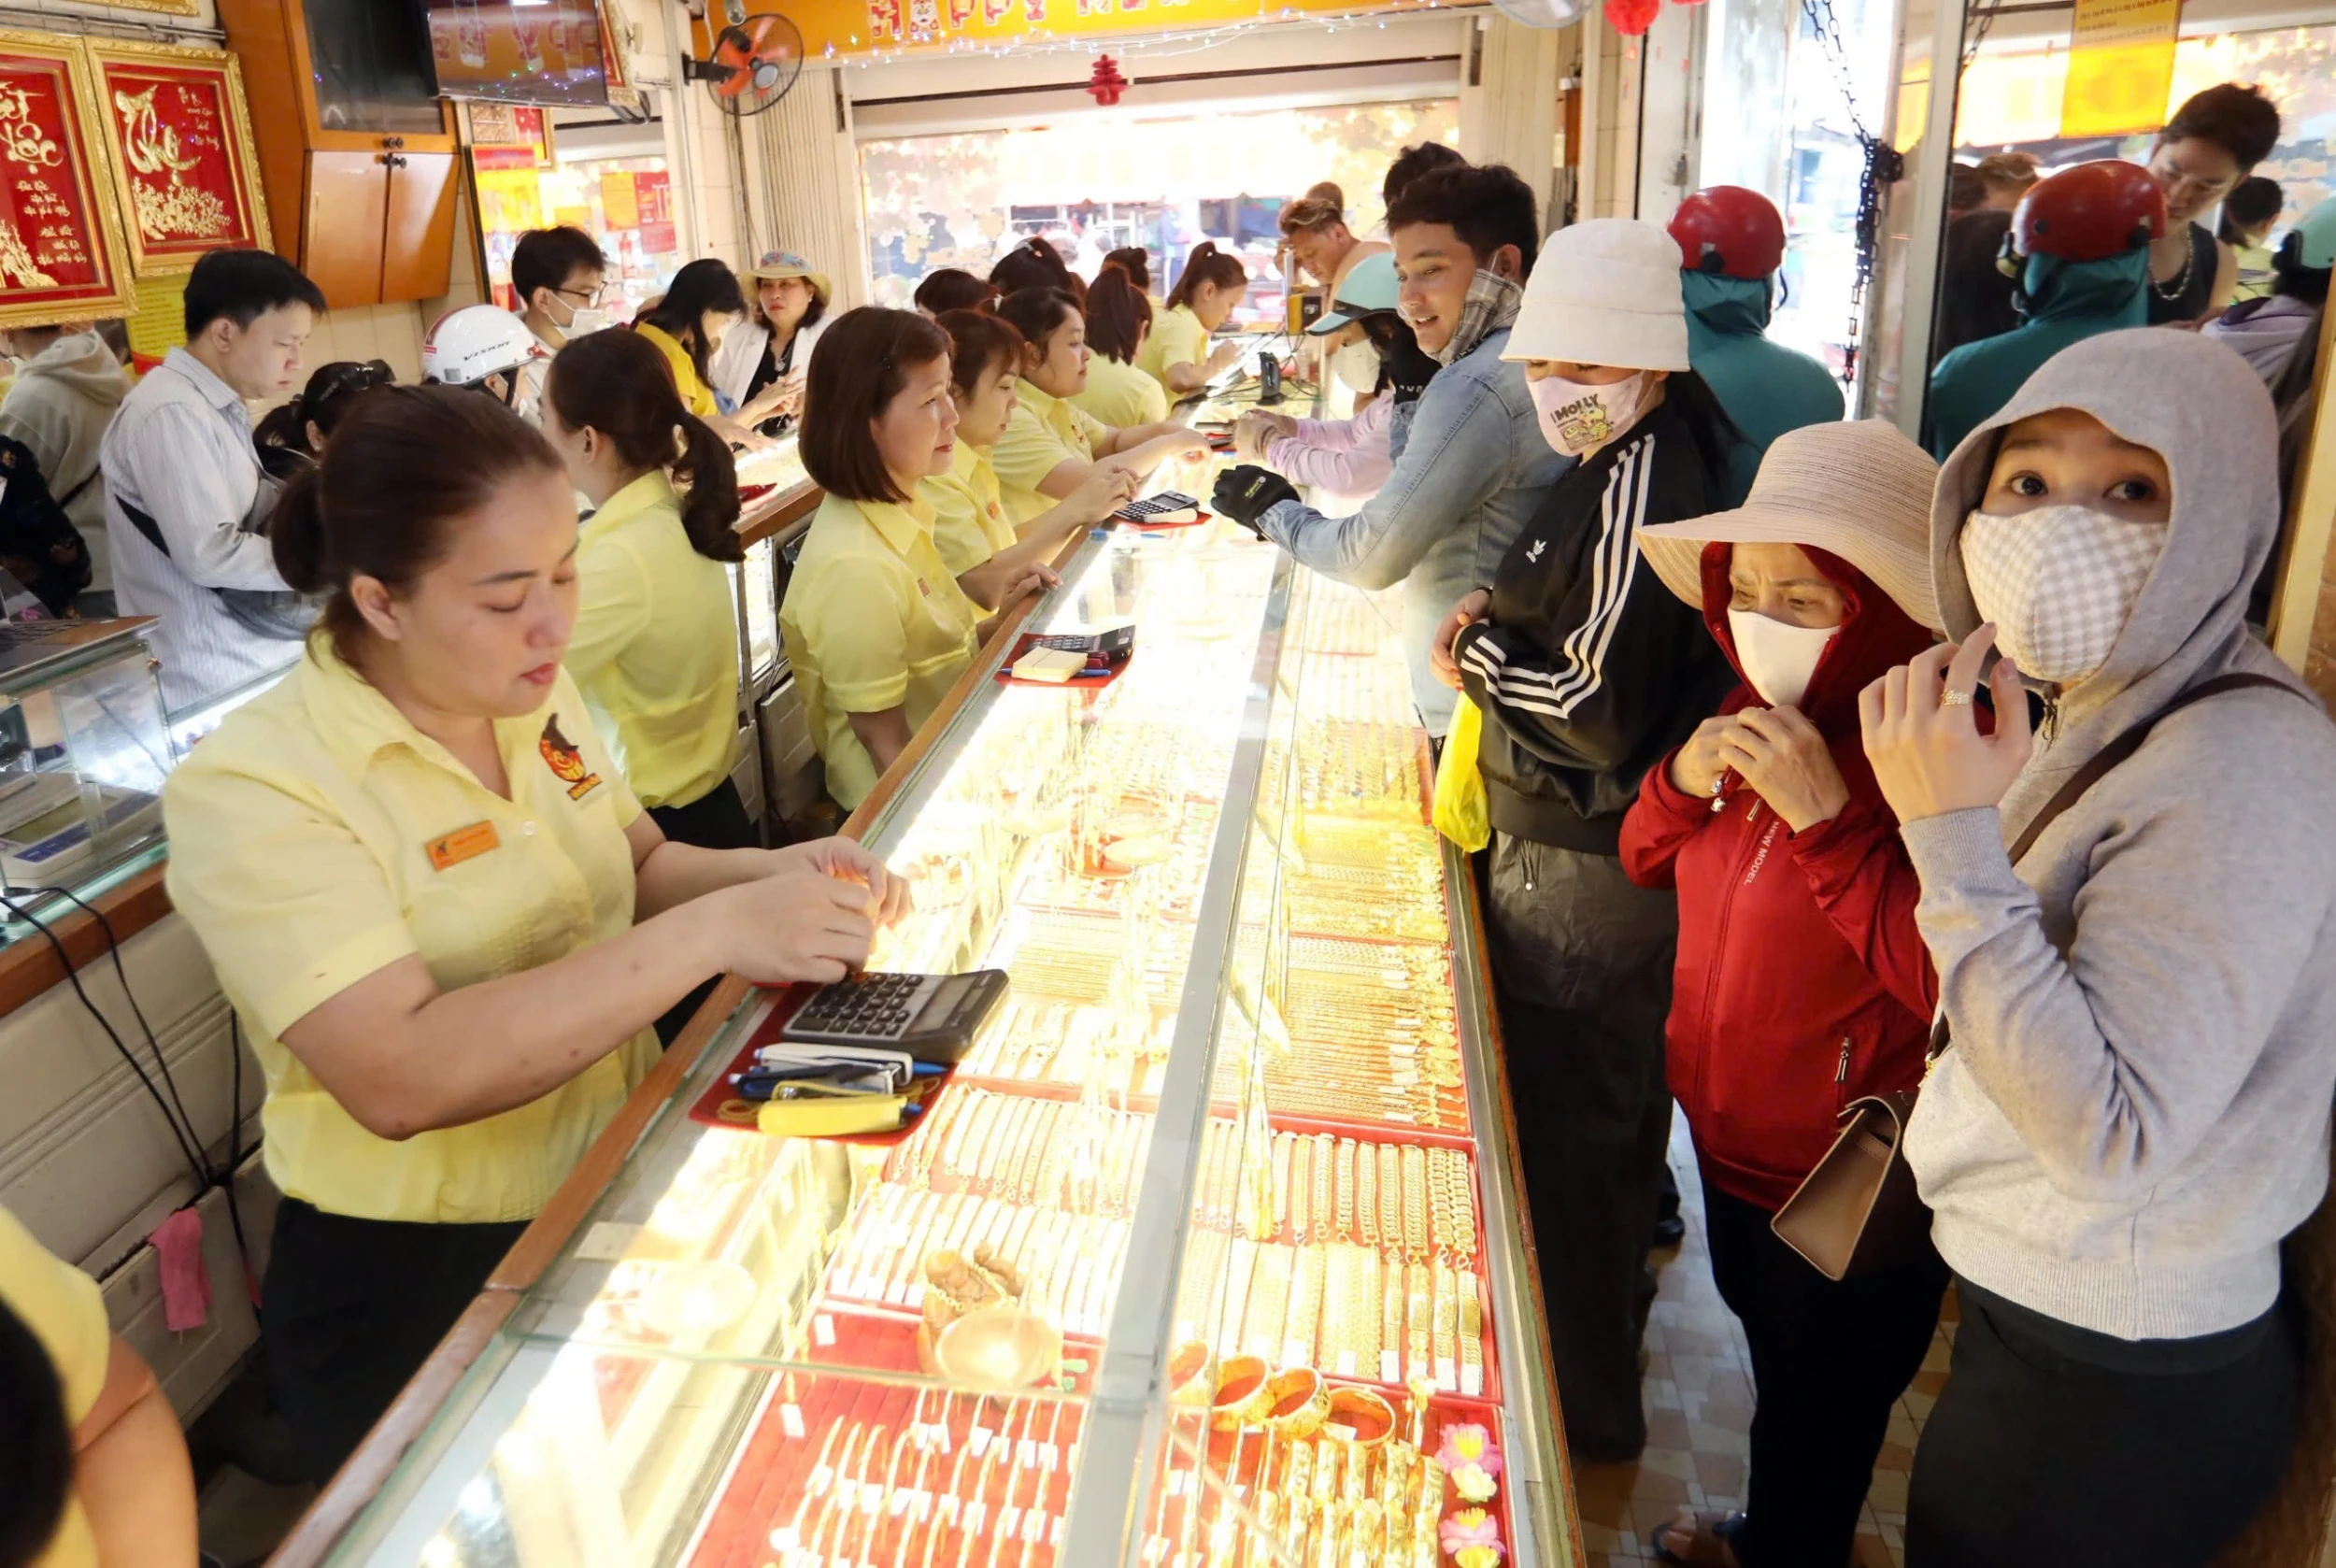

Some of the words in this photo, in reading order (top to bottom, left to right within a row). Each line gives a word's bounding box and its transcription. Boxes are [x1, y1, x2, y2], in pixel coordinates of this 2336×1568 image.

[1555, 393, 1599, 421] MOLLY
[1761, 821, 1780, 848] NEW
[1744, 848, 1769, 886] MODEL
